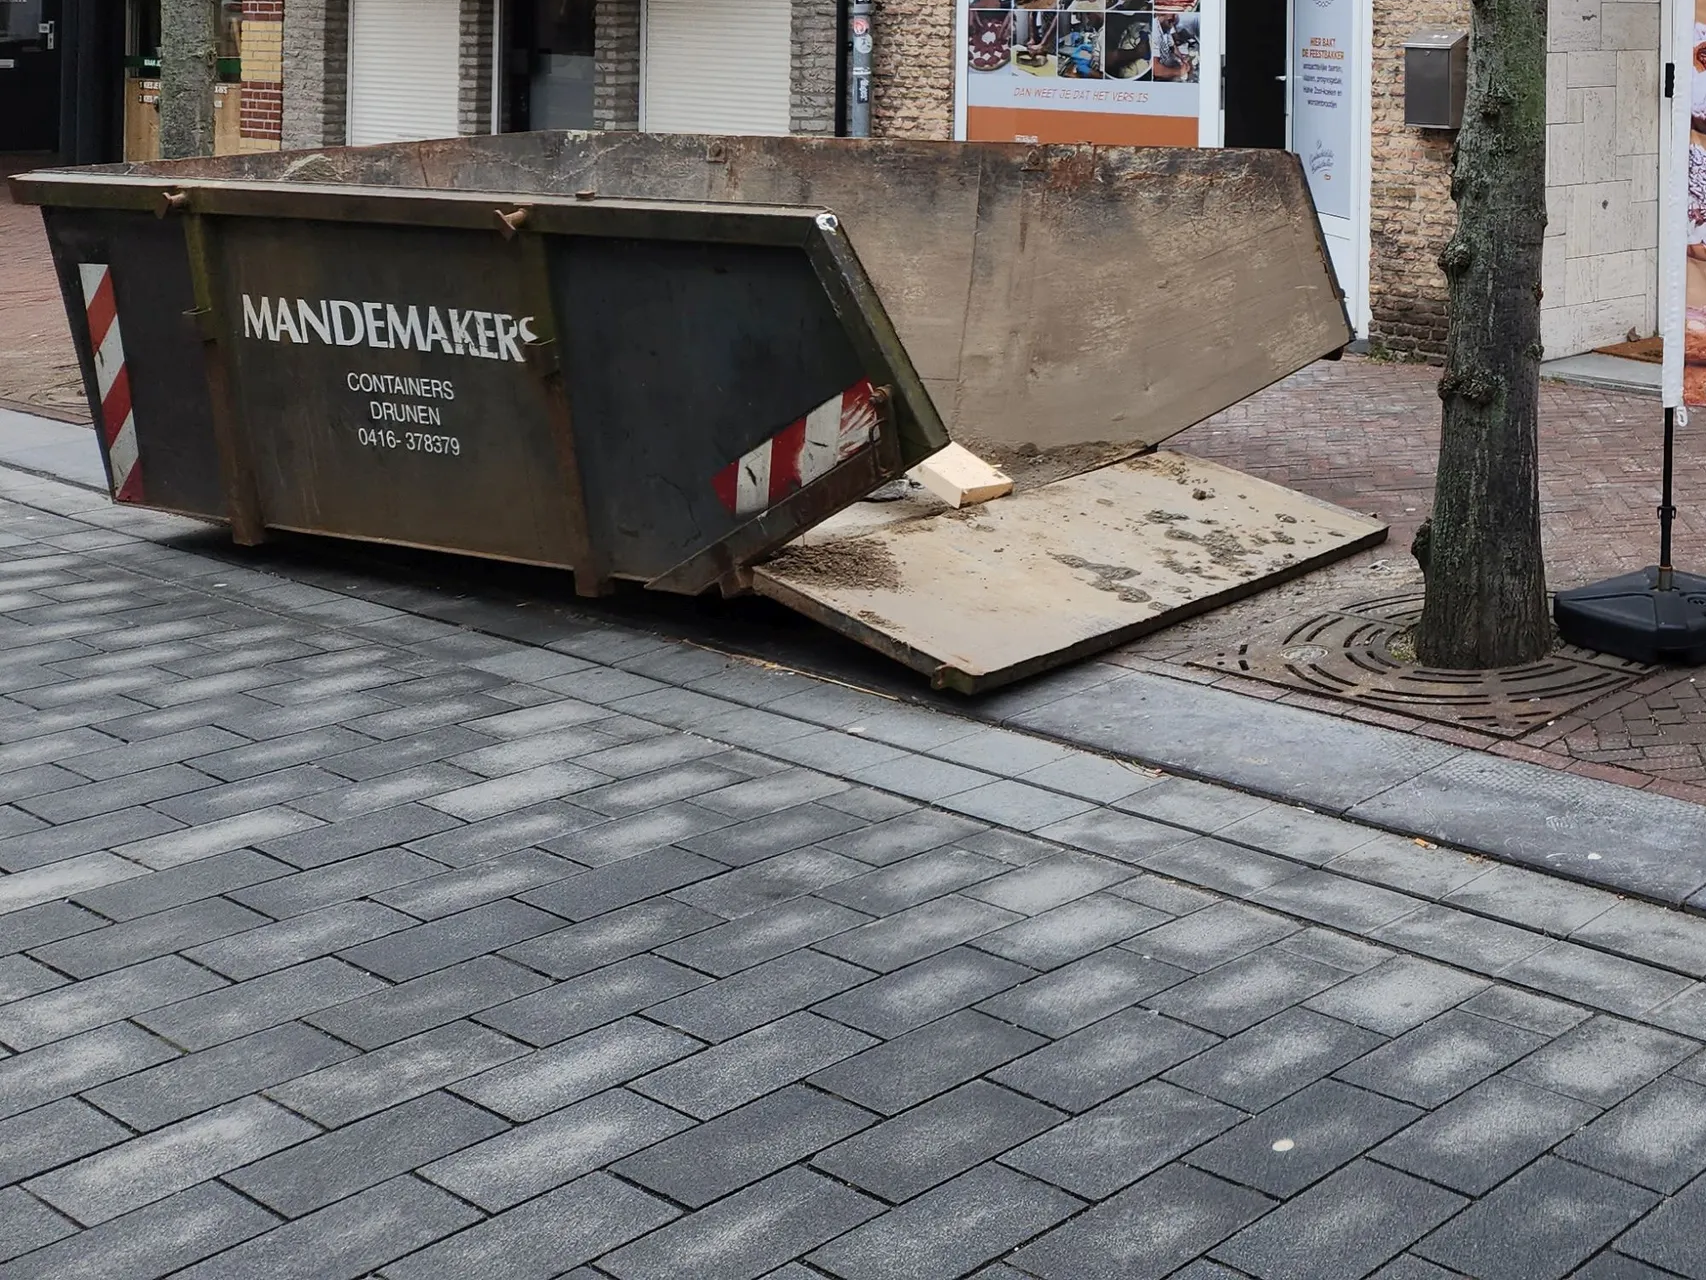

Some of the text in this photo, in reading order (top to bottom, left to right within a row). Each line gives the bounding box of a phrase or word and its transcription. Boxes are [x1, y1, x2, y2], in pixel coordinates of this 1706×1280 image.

[1014, 87, 1149, 103] DAN WEET JE DAT HET VERS IS
[347, 372, 455, 400] CONTAINERS
[369, 401, 441, 426] DRUNEN
